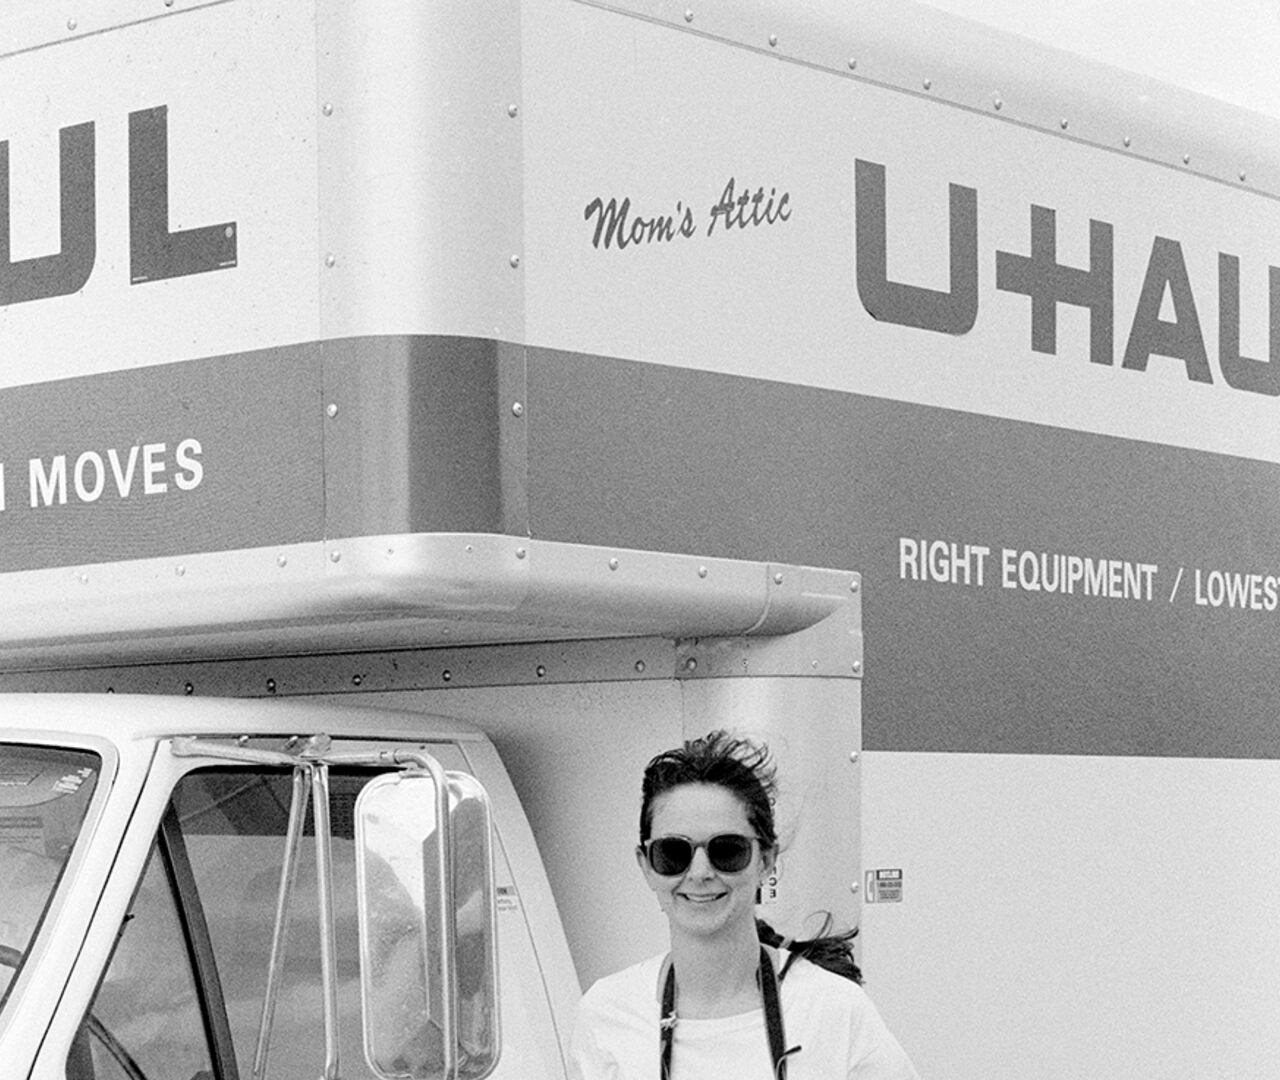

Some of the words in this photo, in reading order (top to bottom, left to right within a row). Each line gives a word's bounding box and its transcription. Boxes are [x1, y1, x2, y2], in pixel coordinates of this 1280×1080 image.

[584, 197, 696, 250] Mom's
[707, 177, 792, 237] Attic
[29, 438, 204, 508] MOVES
[899, 537, 990, 587] RIGHT
[1001, 548, 1159, 601] EQUIPMENT
